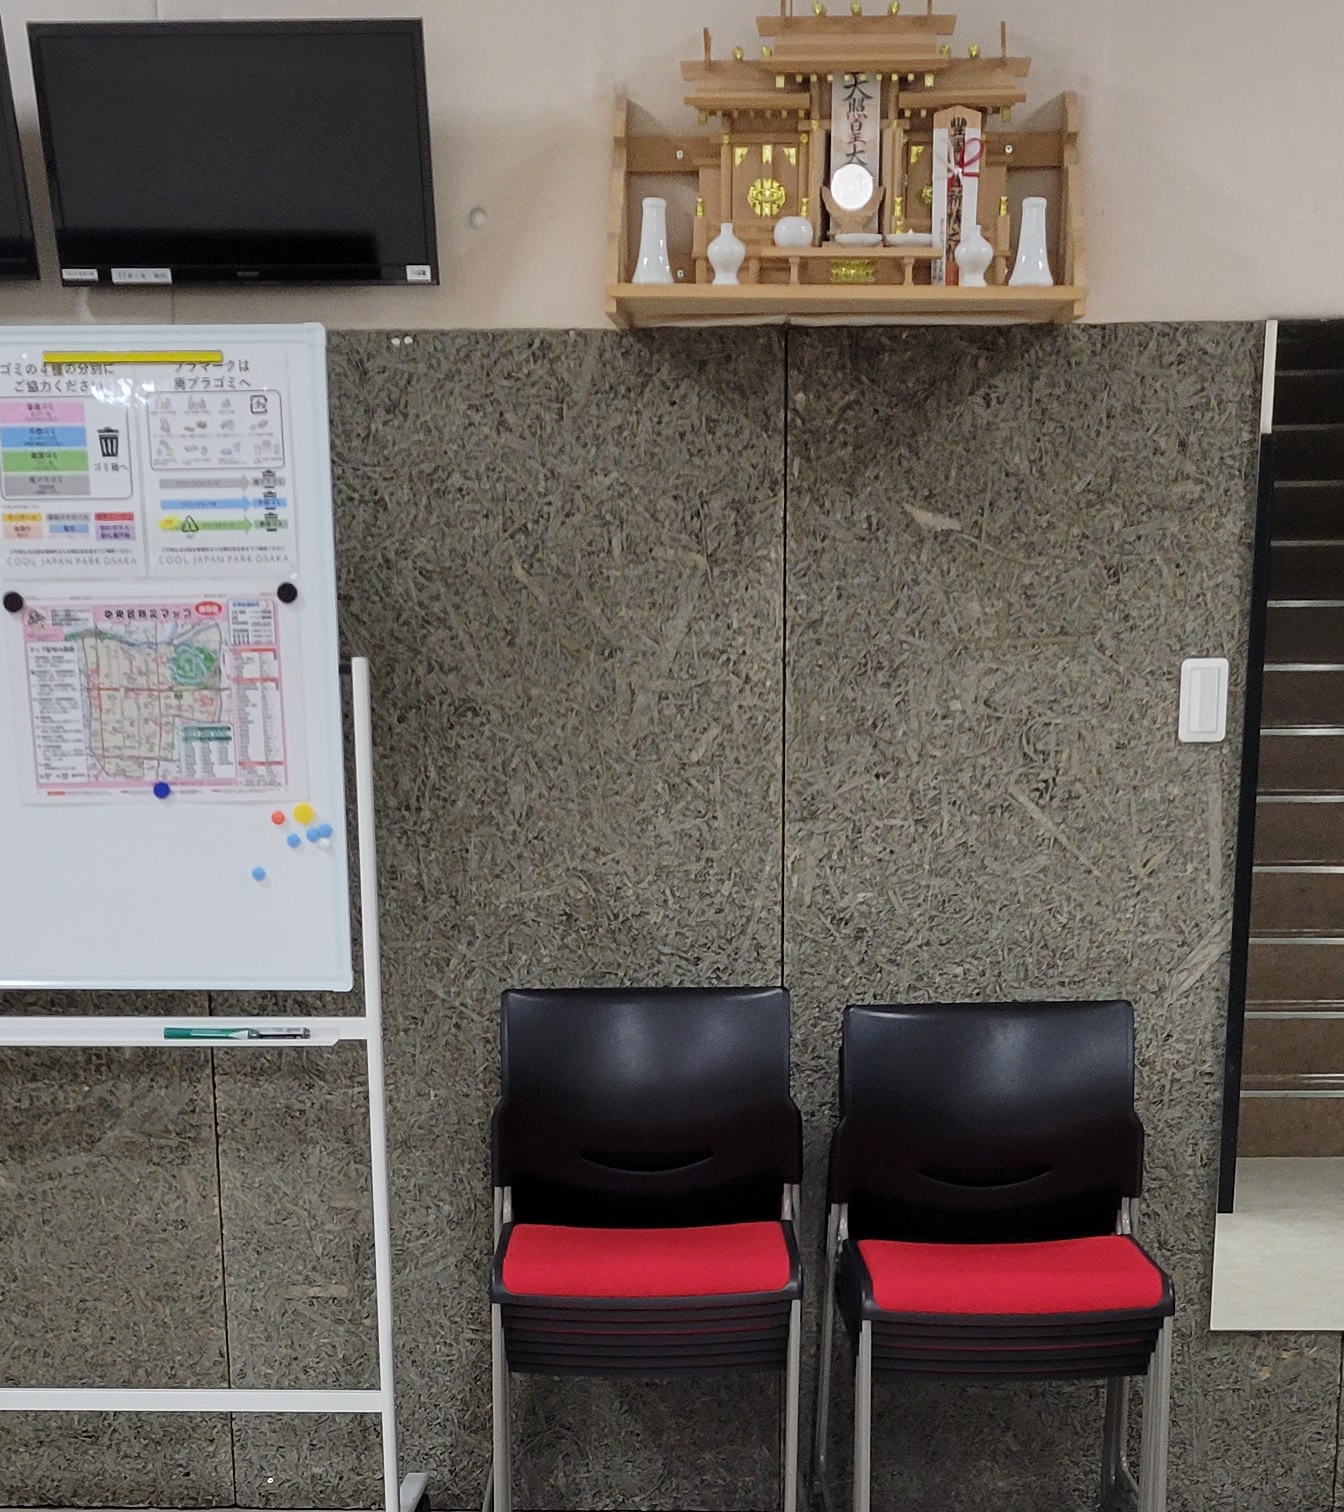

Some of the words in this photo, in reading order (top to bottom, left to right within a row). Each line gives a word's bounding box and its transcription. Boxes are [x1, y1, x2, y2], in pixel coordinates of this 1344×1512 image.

[41, 557, 73, 566] JAPAN
[76, 557, 100, 565] PARK
[103, 557, 137, 565] OSAKA
[158, 555, 190, 565] COOL
[193, 555, 224, 564] JAPAN
[227, 555, 252, 563] PARK
[255, 554, 289, 563] OSAKA
